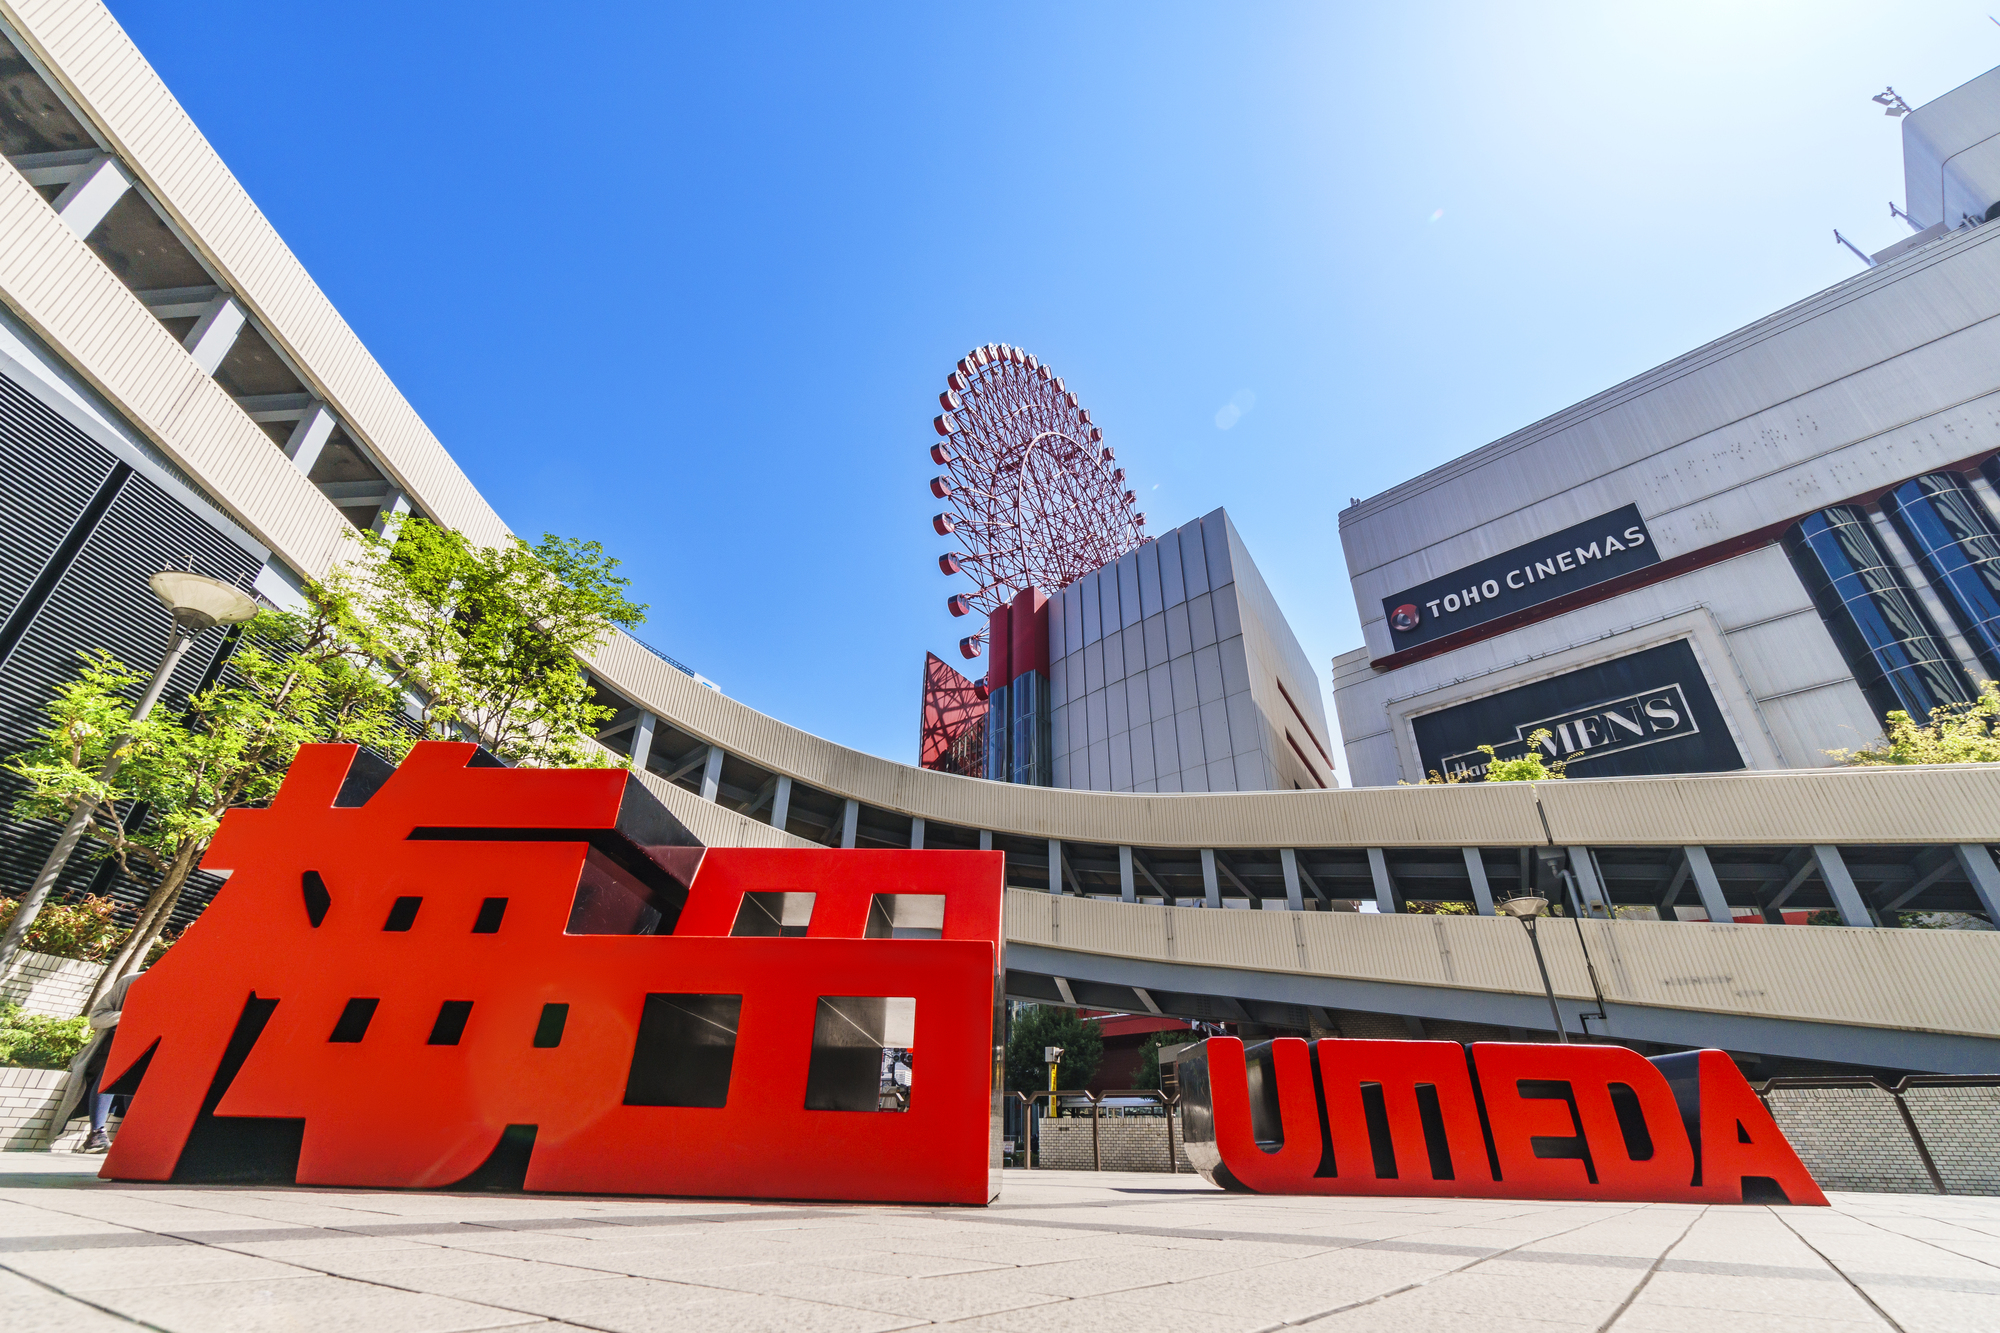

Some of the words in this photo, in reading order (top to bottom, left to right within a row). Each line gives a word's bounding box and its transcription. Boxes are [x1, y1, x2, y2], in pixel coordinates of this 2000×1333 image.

[1426, 579, 1500, 618] TOHO
[1506, 526, 1646, 590] CINEMAS
[1529, 696, 1680, 760] MEN'S
[97, 741, 1005, 1206] 梅田
[1206, 1035, 1831, 1206] UMEDA
